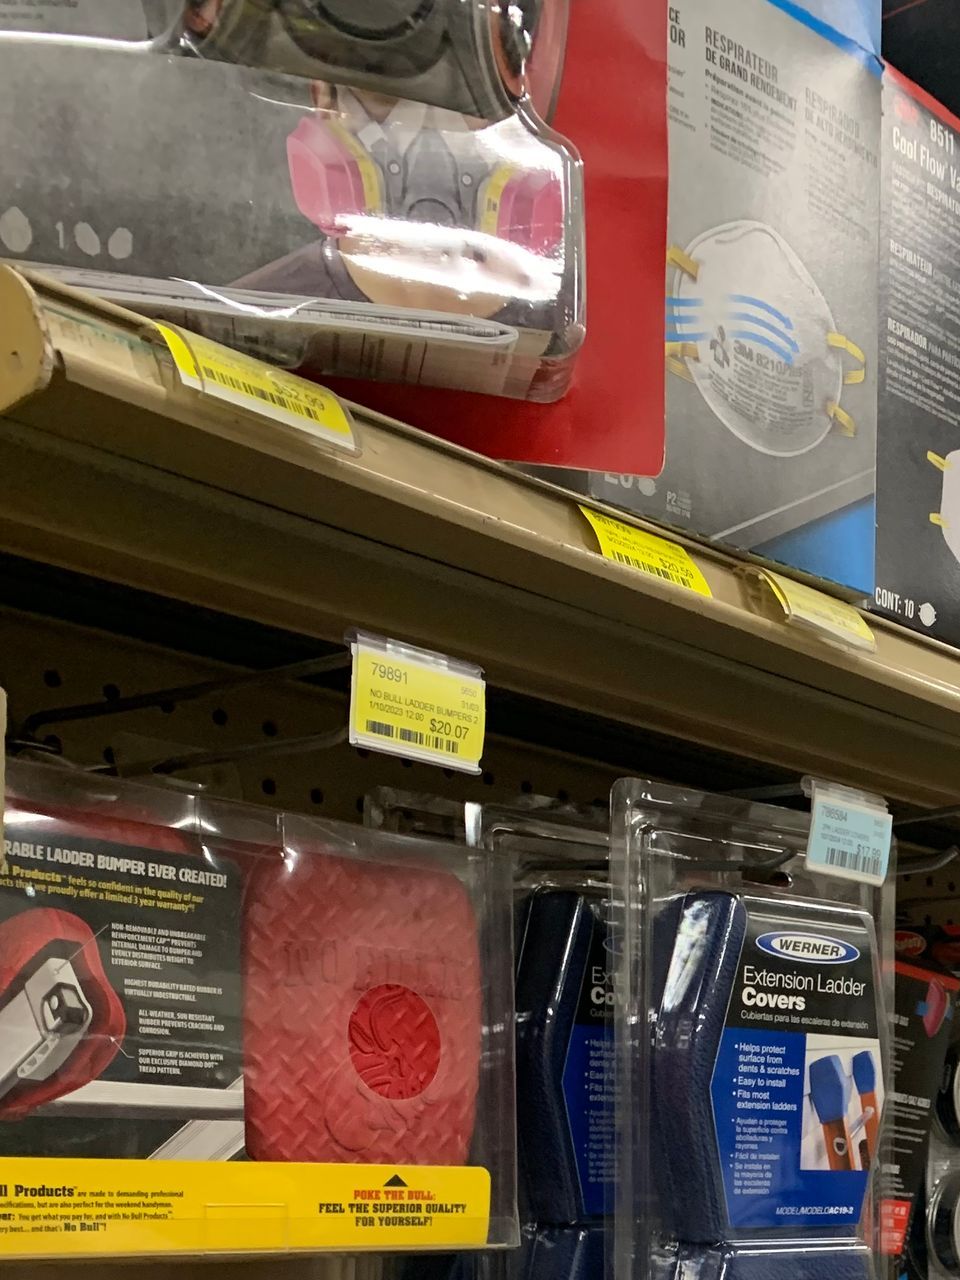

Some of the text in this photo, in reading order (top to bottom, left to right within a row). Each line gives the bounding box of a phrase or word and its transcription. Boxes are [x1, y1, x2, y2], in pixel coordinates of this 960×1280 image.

[704, 26, 779, 83] RESPIRATEUR
[705, 47, 798, 112] DE GRAND RENDEMENT
[892, 126, 917, 161] Cool
[930, 119, 955, 156] 8511
[887, 317, 927, 350] RESPIRADOR
[875, 586, 915, 619] CONT: 10
[370, 662, 409, 685] 79891
[370, 688, 473, 723] NO BULL LADDER BUMPERS
[429, 718, 470, 740] $20.07
[47, 847, 228, 889] LADDER BUMPER EVER CREATED!
[47, 885, 132, 904] proudly limited
[68, 874, 182, 902] feels confident quality
[779, 938, 842, 957] WERNER
[743, 965, 866, 997] Extension Ladder
[741, 987, 806, 1011] Covers
[738, 1054, 783, 1065] surface from
[739, 1043, 786, 1055] Helps protect
[738, 1065, 800, 1077] dents scratches
[738, 1076, 787, 1088] Easy install
[737, 1090, 770, 1100] Fits most
[736, 1101, 797, 1112] extension ladders
[116, 1190, 184, 1200] demanding professional
[354, 1190, 404, 1201] POKE THE
[318, 1203, 467, 1214] FEEL THE SUPERIOR QUALITY
[355, 1216, 433, 1227] FOR YOURSELF!
